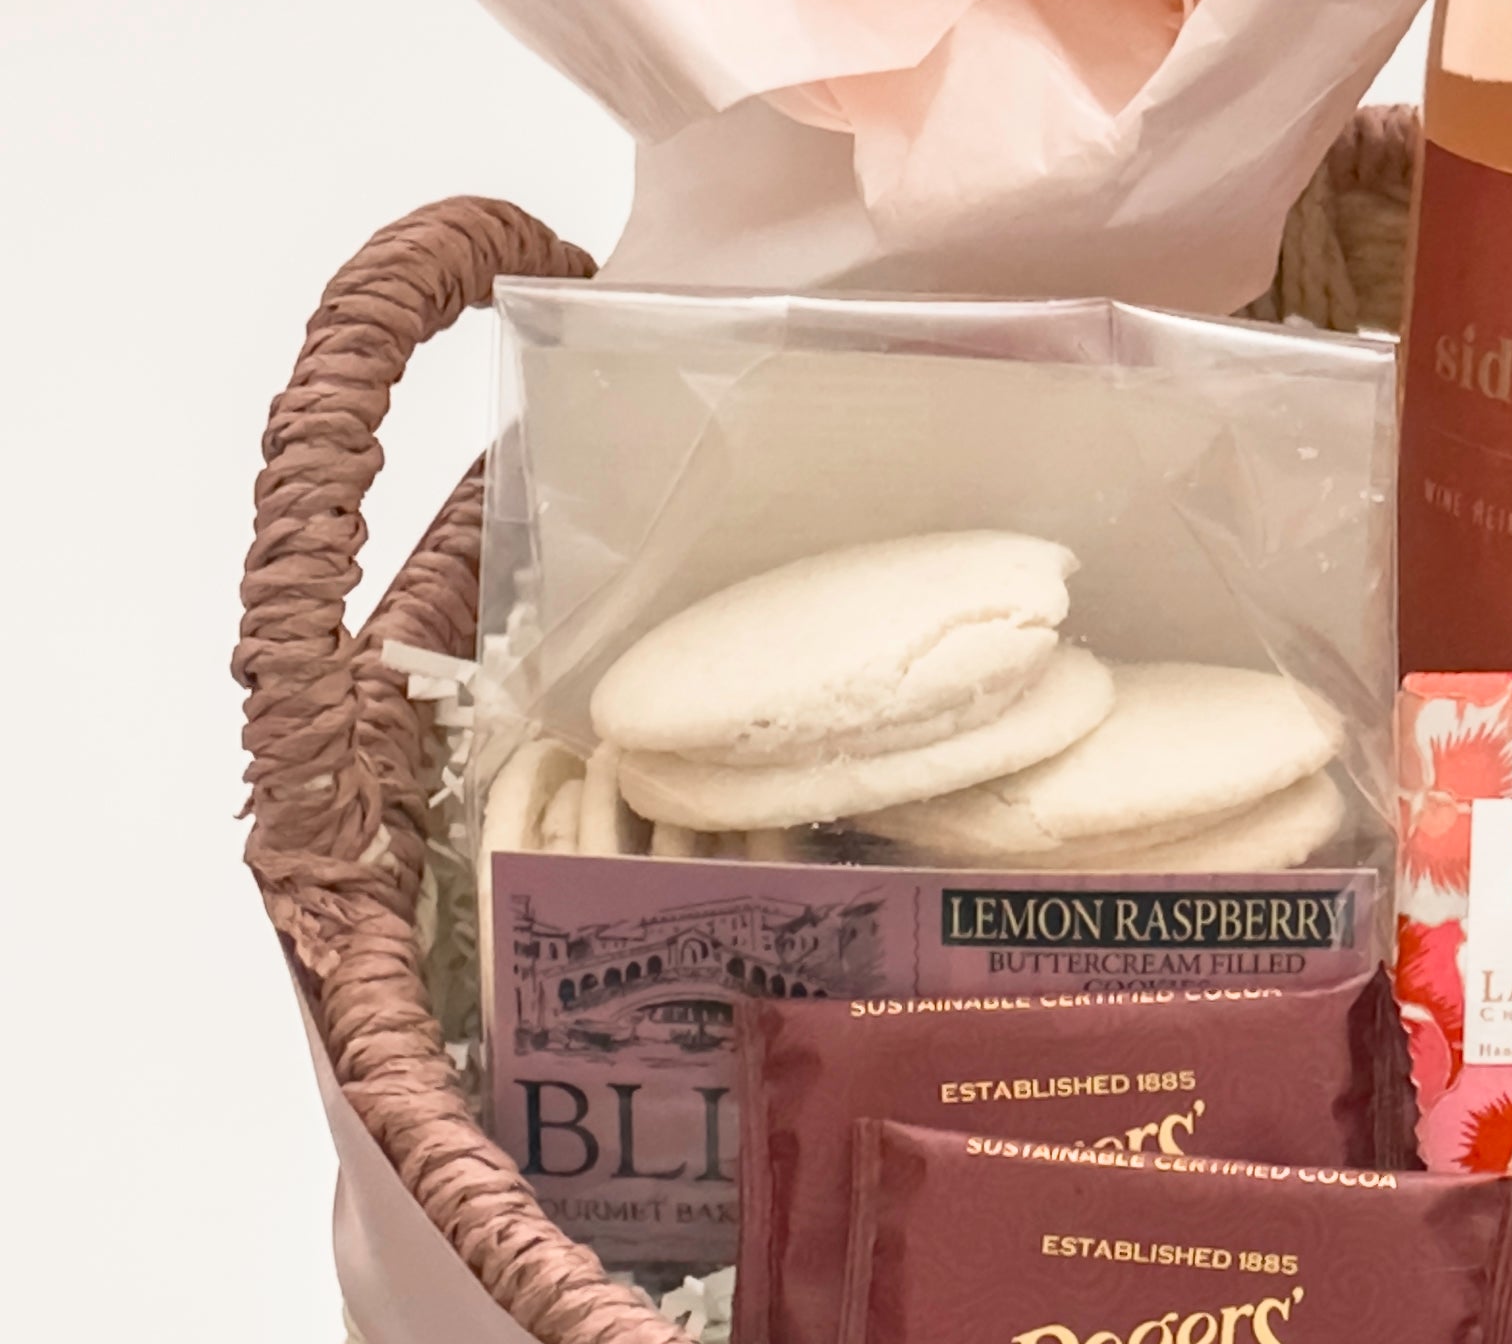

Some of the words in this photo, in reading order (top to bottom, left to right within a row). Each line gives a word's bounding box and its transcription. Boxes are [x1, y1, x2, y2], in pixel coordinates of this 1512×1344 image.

[1424, 478, 1462, 517] WINE
[949, 894, 1105, 941] LEMON
[1115, 895, 1349, 943] RASPBERRY
[988, 950, 1200, 975] BUTTERCREAM
[1209, 952, 1307, 975] FILLED
[850, 996, 1031, 1017] SUSTAINABLE
[941, 1074, 1131, 1103] ESTABLISHED
[1136, 1070, 1196, 1093] 1885
[966, 1136, 1146, 1168] SUSTAINABLE
[1298, 1167, 1398, 1189] COCOA
[1041, 1234, 1233, 1271] ESTABLISHED
[1238, 1252, 1300, 1276] 1885
